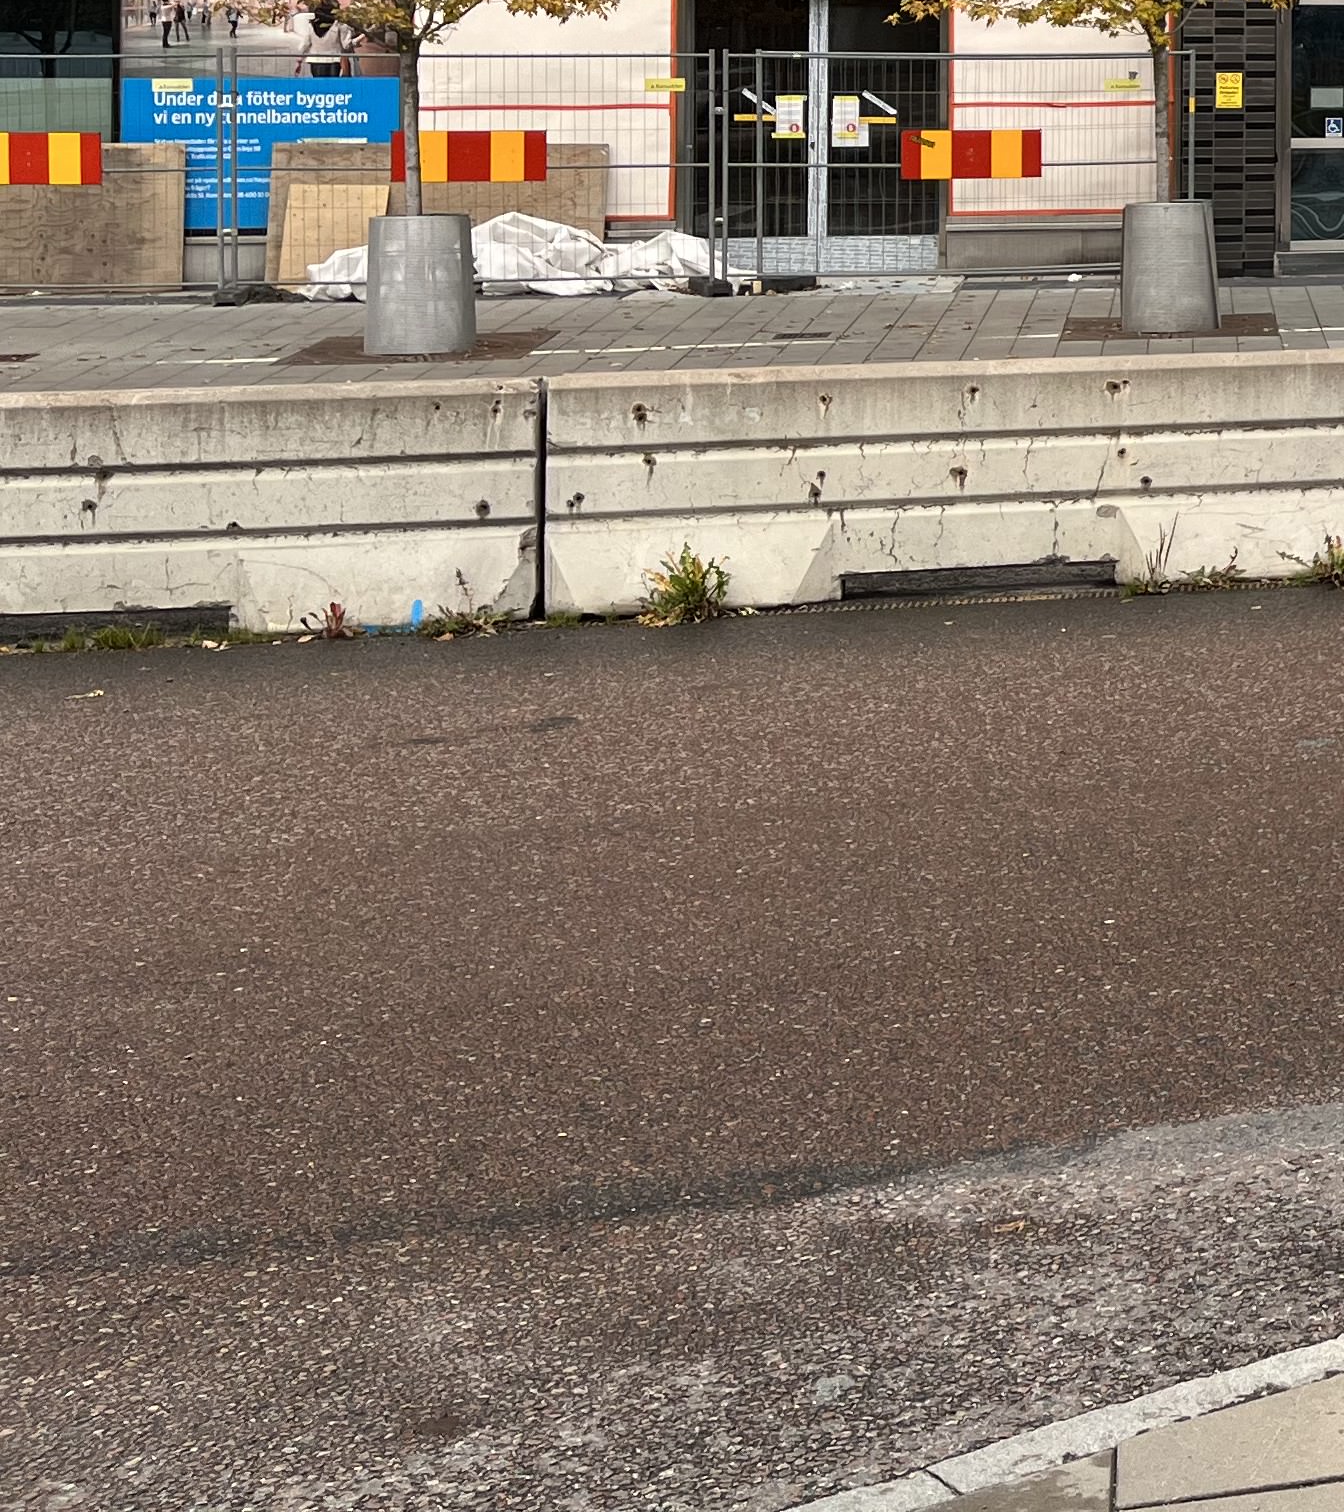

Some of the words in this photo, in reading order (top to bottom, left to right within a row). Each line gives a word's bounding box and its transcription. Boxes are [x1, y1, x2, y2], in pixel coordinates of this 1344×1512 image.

[153, 92, 203, 106] Under
[208, 91, 243, 106] dna
[246, 90, 292, 106] fötter
[296, 91, 352, 110] bygger
[153, 110, 168, 124] vi
[172, 112, 192, 124] en
[196, 112, 215, 128] ny
[221, 109, 368, 124] tunnelbanestation
